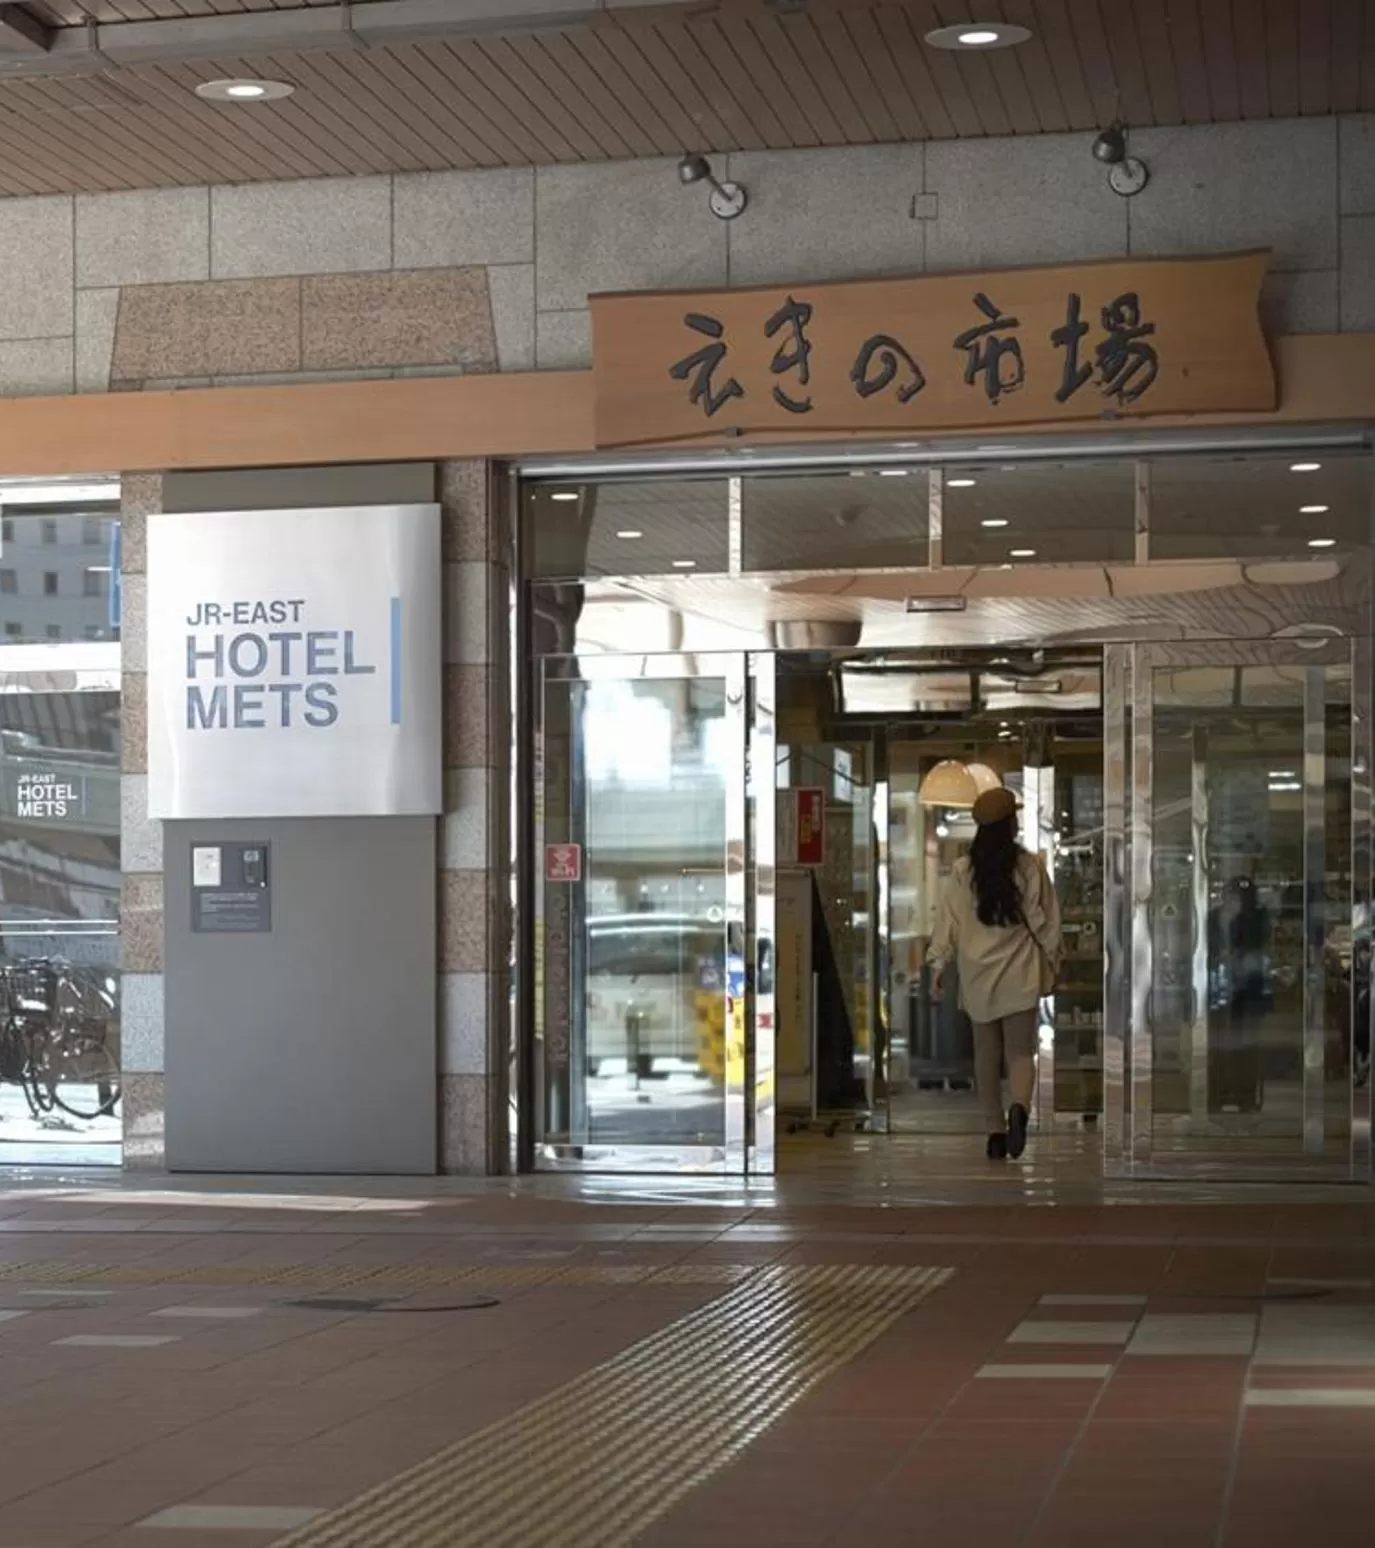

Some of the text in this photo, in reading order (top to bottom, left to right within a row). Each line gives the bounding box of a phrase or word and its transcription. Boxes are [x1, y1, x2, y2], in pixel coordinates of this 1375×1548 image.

[669, 294, 1160, 416] えきの市場
[186, 600, 305, 626] JR-EAST
[186, 630, 376, 679] HOTEL
[186, 682, 339, 729] METS
[17, 784, 78, 800] HOTEL
[17, 800, 67, 817] METS
